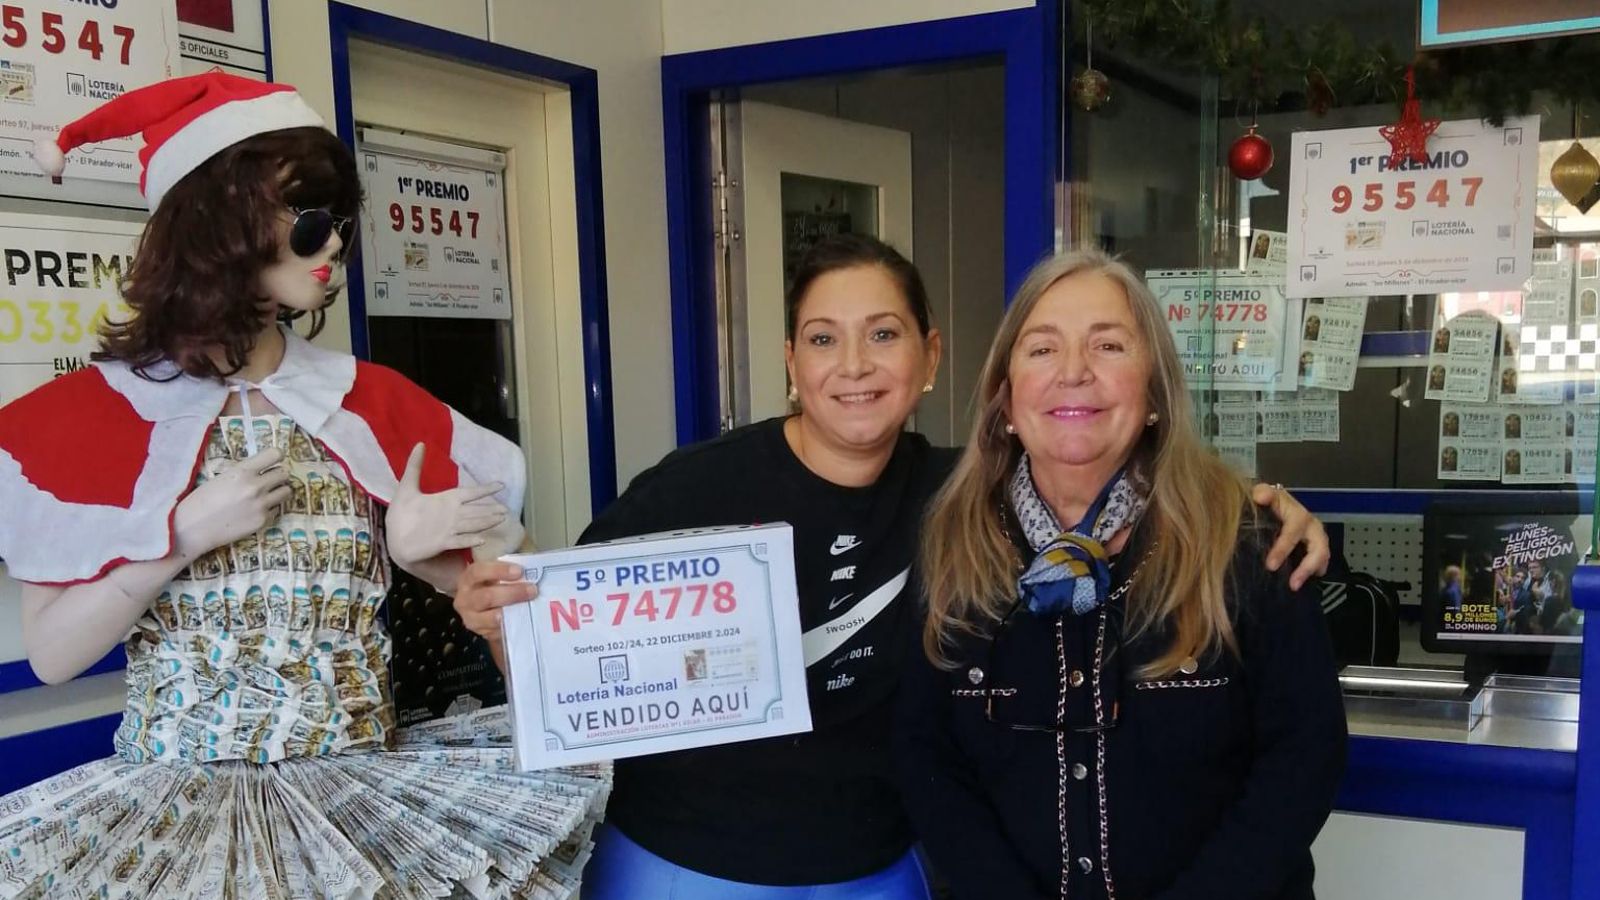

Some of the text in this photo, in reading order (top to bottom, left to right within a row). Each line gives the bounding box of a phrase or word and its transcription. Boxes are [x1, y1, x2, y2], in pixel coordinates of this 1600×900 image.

[188, 43, 229, 60] OFICIALES
[88, 79, 125, 93] LOTERÍA
[398, 176, 470, 202] 1er PREMIO
[1431, 220, 1467, 229] LOTERÍA
[1431, 227, 1475, 237] NACIONAL
[1204, 289, 1261, 301] PREMIO
[1198, 304, 1267, 321] 74778
[835, 534, 857, 546] NIKE
[1508, 526, 1549, 544] LUNES
[1505, 534, 1558, 555] PELIGRO
[1492, 541, 1574, 569] EXTINCIÓN
[576, 556, 721, 592] 5º PREMIO
[830, 565, 857, 582] NIKE
[549, 580, 737, 633] Nº 74778
[1461, 604, 1491, 613] BOTE
[825, 616, 865, 634] SWOOSH
[1444, 612, 1463, 623] 8,9
[1455, 623, 1497, 631] DOMINGO
[573, 627, 741, 655] Sorteo 102/24, 22 DICIEMBRE 2.024
[850, 648, 862, 659] DO
[863, 646, 874, 657] IT.
[614, 678, 678, 697] Nacional
[827, 673, 855, 691] nike
[568, 685, 750, 733] VENDIDO AQUÍ
